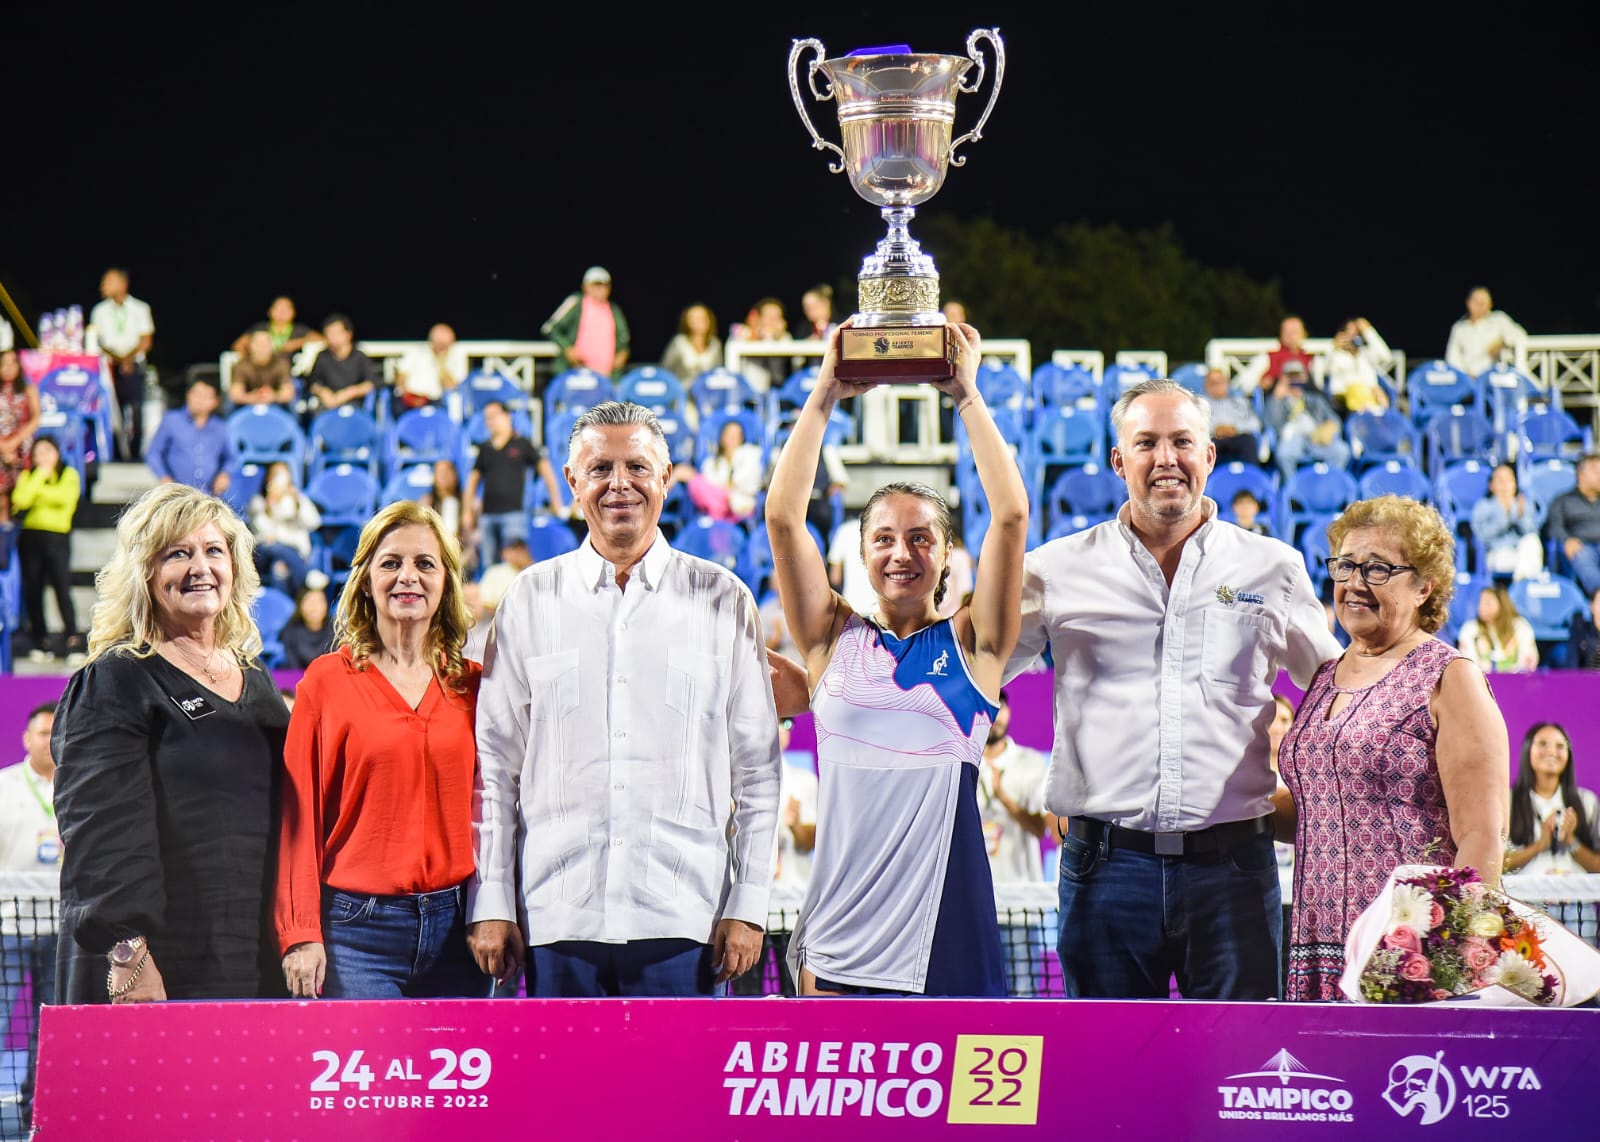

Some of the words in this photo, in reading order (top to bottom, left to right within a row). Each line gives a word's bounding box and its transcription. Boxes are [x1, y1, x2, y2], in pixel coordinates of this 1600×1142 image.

[310, 1049, 375, 1091] 24
[385, 1058, 422, 1080] AL
[428, 1047, 492, 1090] 29
[723, 1041, 943, 1074] ABIERTO
[968, 1047, 1028, 1076] 20
[1460, 1065, 1542, 1090] WTA
[310, 1096, 335, 1109] DE
[343, 1095, 435, 1109] OCTUBRE
[443, 1095, 489, 1108] 2022
[722, 1077, 943, 1118] TAMPICO
[968, 1077, 1023, 1106] 22
[1218, 1086, 1353, 1111] TAMPICO
[1218, 1110, 1262, 1120] UNIDOS
[1263, 1111, 1327, 1122] BRILLAMOS
[1328, 1111, 1354, 1122] MÁS
[1462, 1094, 1510, 1118] 125
